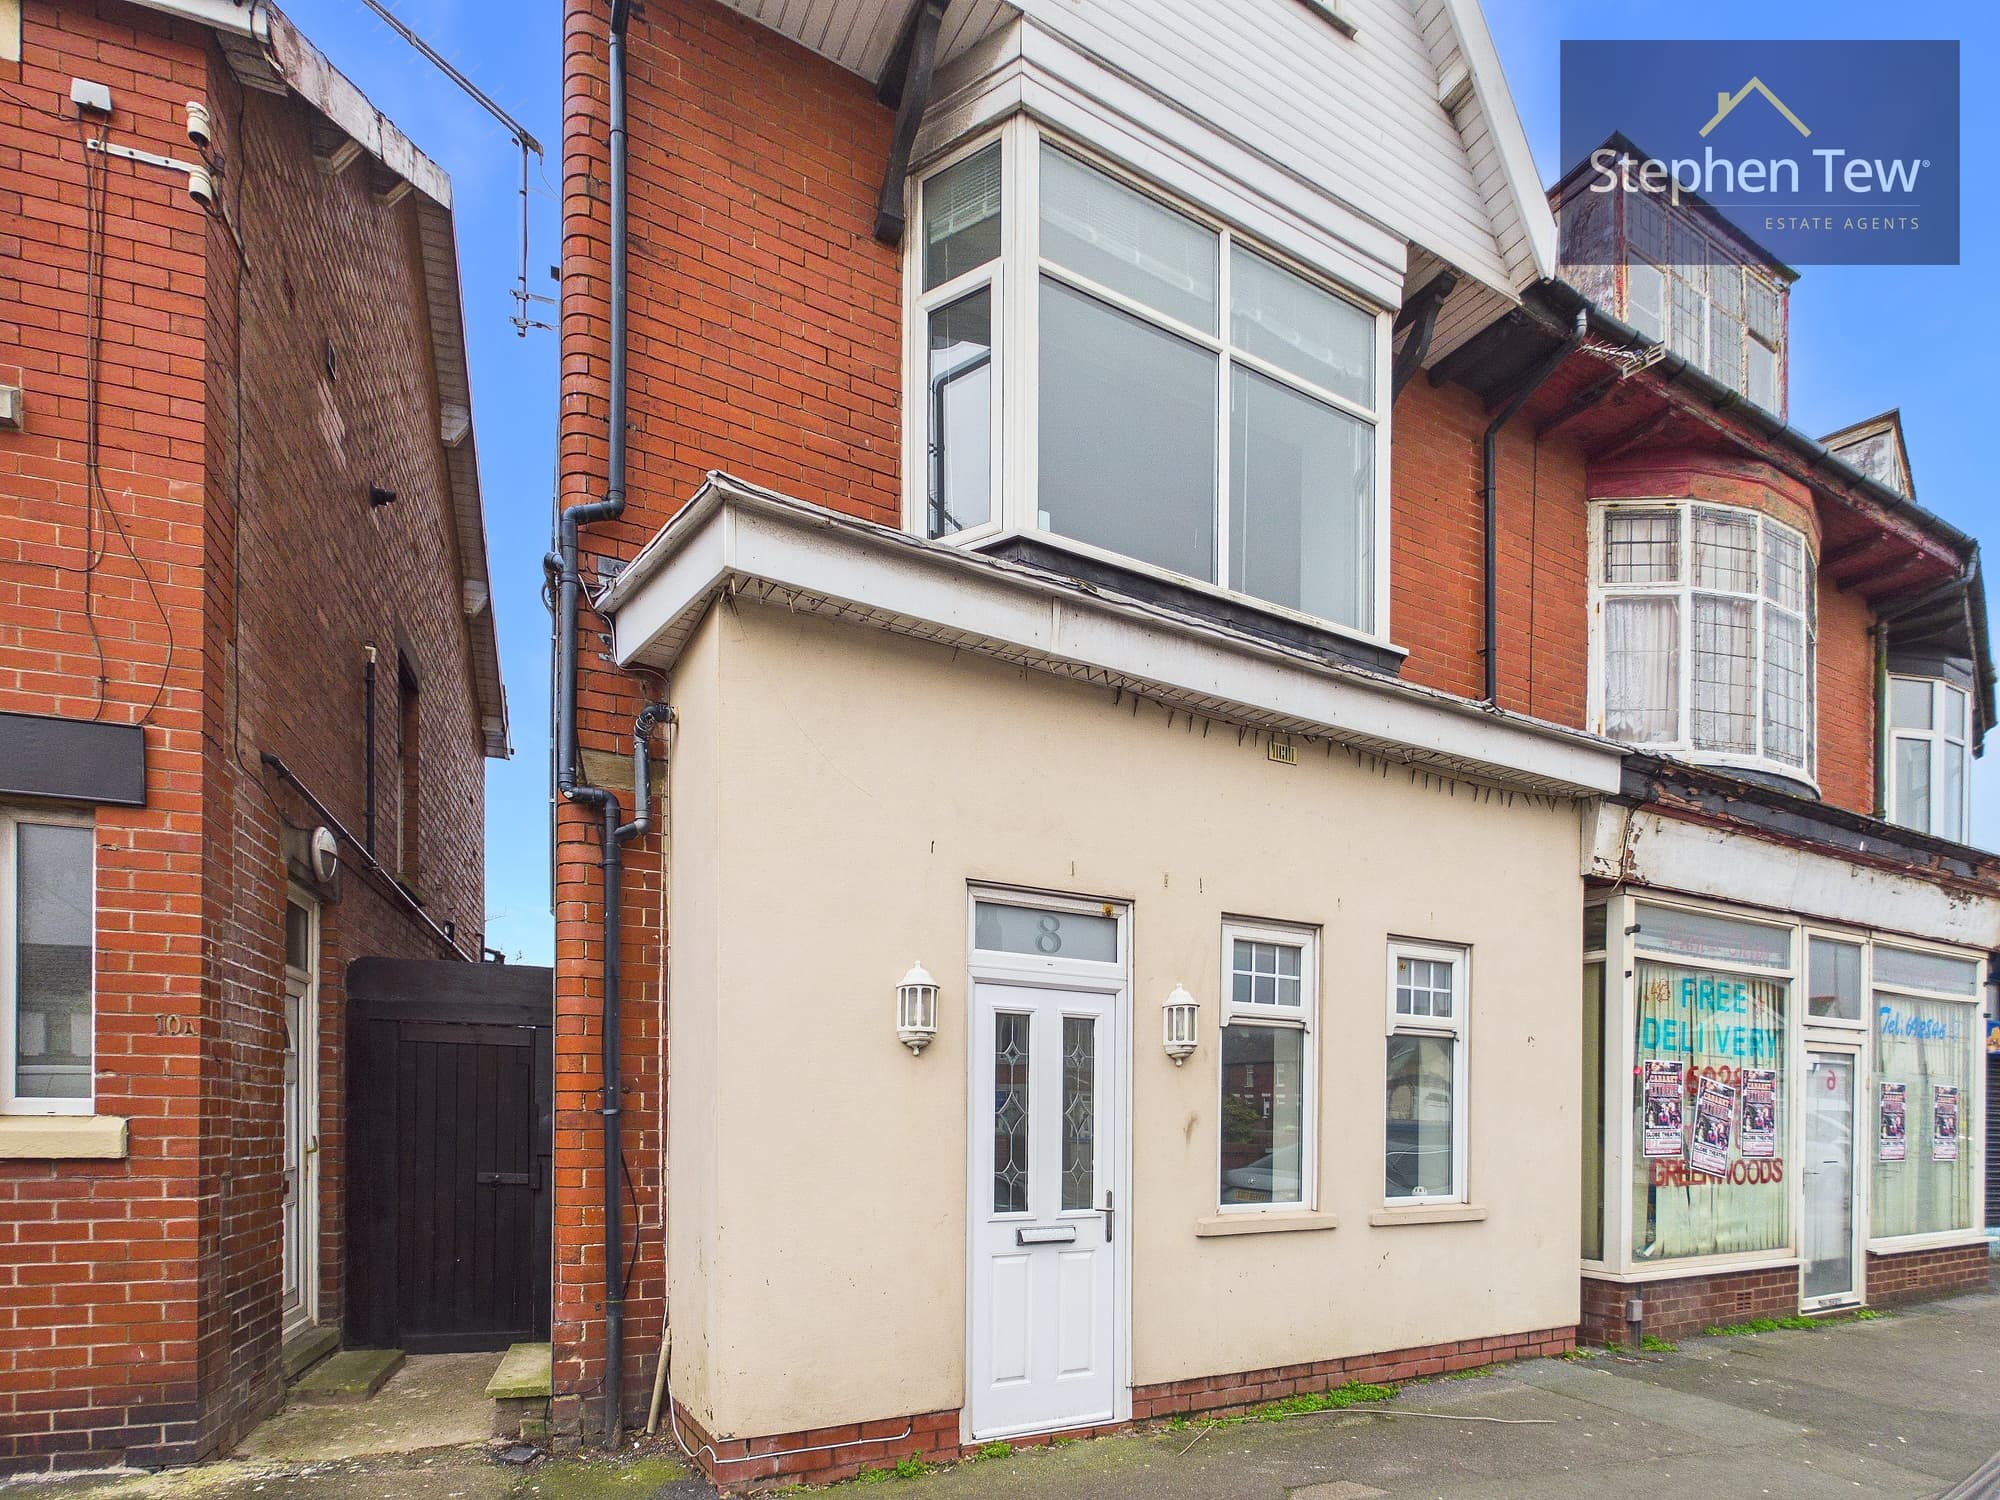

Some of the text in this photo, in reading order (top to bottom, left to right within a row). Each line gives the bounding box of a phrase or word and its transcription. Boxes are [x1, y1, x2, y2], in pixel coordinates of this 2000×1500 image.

[1035, 913, 1062, 954] 8
[1681, 977, 1747, 1014] FREE
[155, 1014, 199, 1036] 10A
